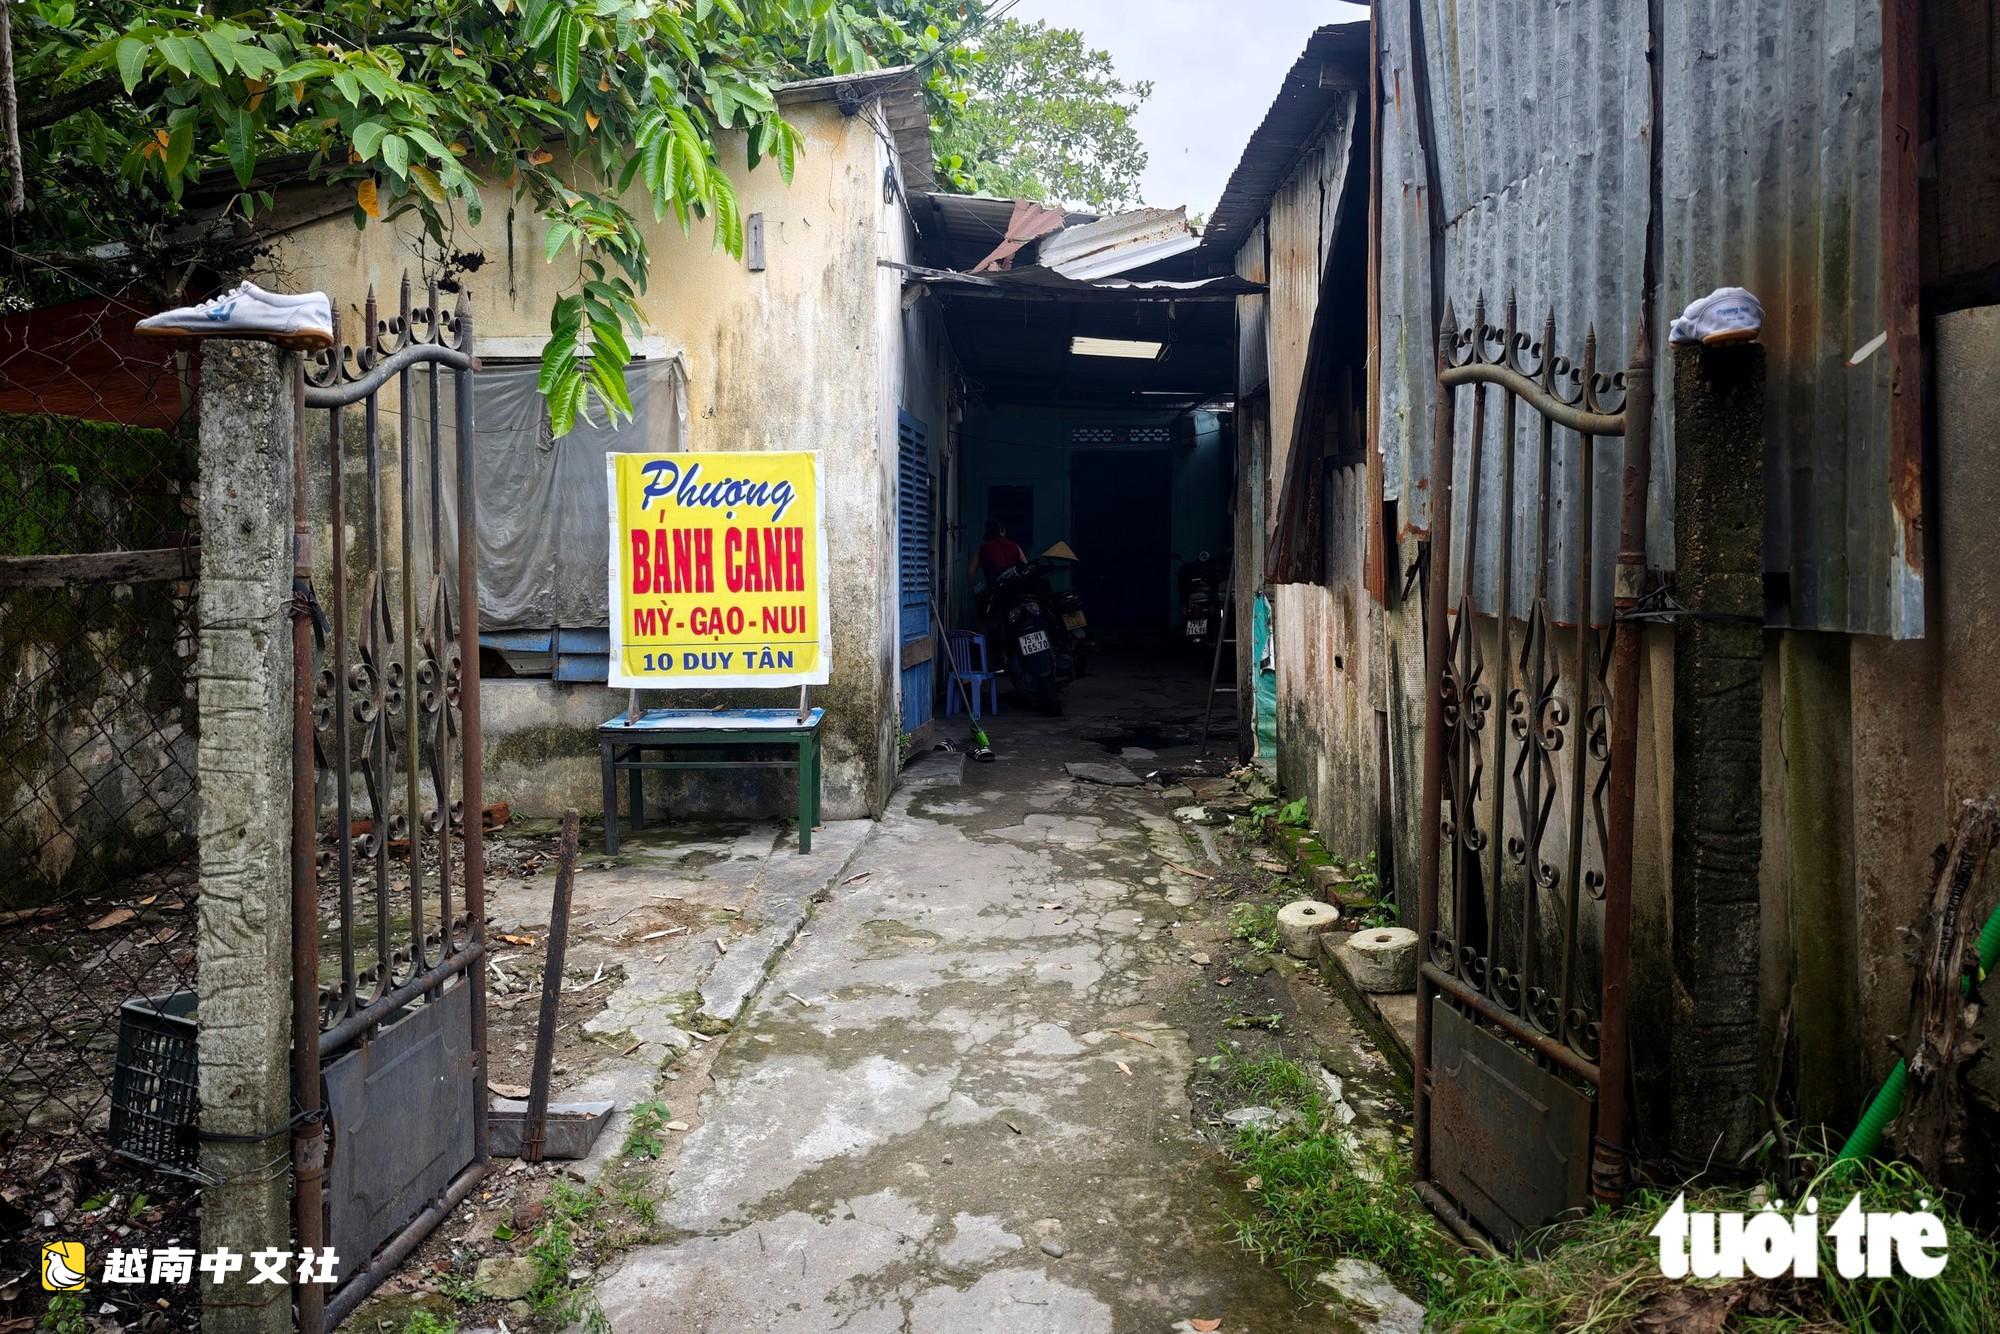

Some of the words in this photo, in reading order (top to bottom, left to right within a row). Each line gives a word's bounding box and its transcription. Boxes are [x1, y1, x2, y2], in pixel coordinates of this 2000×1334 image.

[641, 460, 795, 522] Phượng
[631, 509, 715, 594] BÁNH
[725, 527, 805, 593] CANH
[643, 653, 673, 671] 10
[683, 652, 734, 670] DUY
[743, 646, 793, 669] TÂN
[1024, 640, 1048, 654] 165.70
